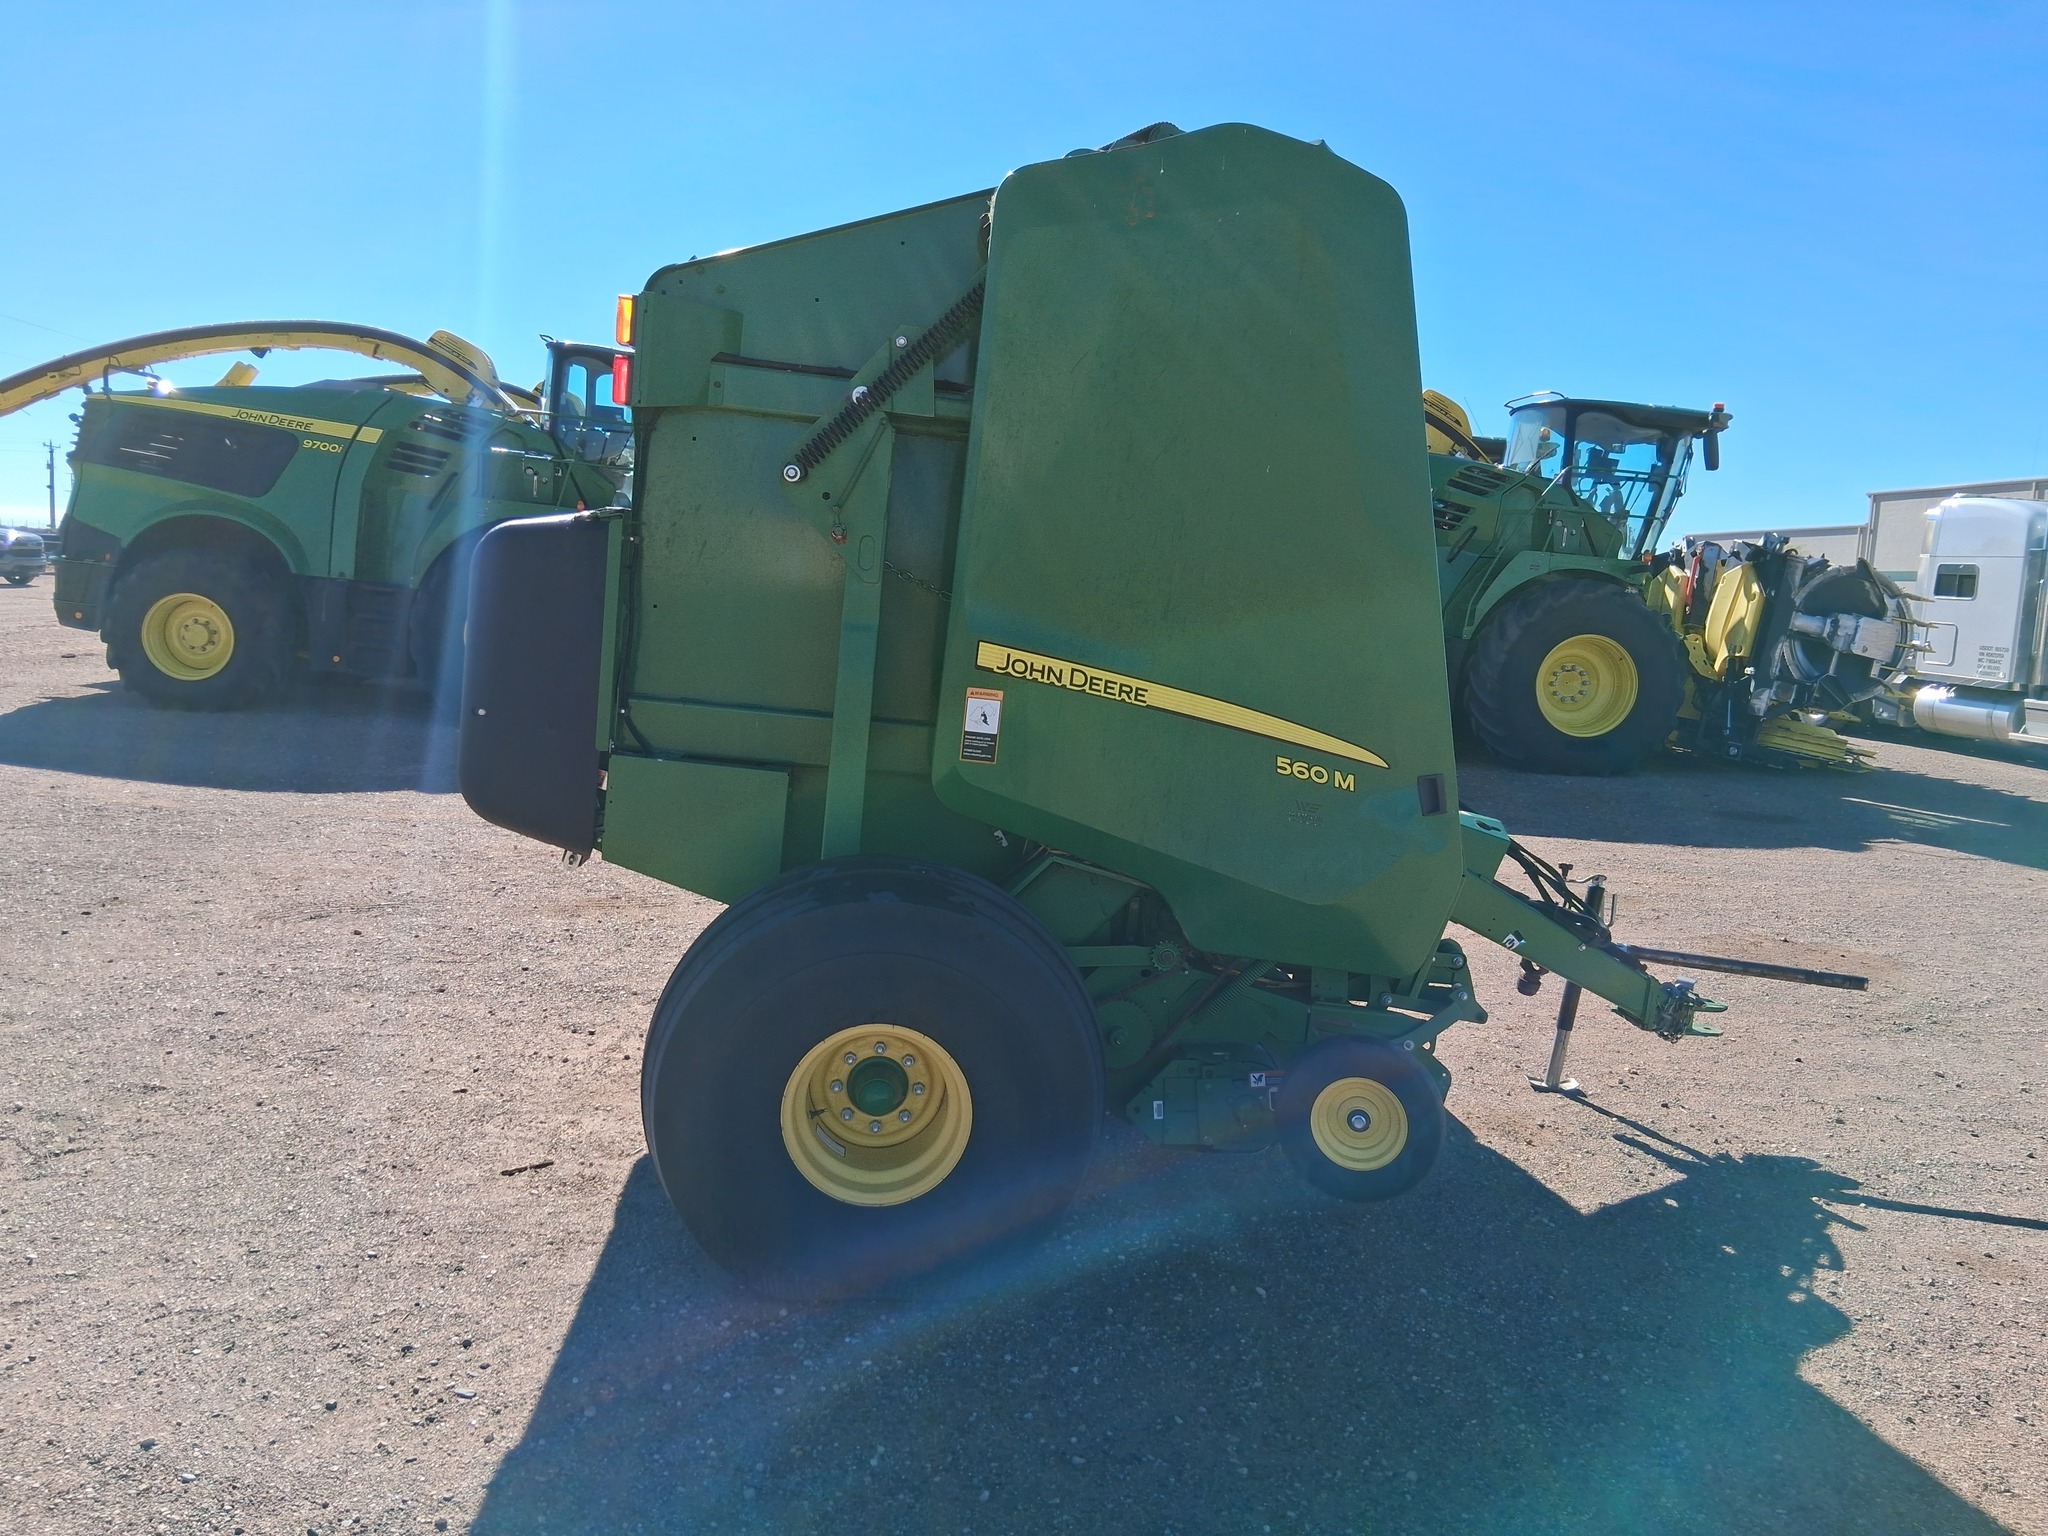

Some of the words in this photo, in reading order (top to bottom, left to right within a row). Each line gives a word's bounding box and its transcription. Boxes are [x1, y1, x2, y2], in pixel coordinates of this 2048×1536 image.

[231, 409, 267, 423] JOHN
[268, 414, 313, 431] DEERE
[302, 439, 344, 454] 9700i
[996, 652, 1063, 684] JOHN
[1069, 667, 1149, 704] DEERE
[974, 690, 999, 698] WARNING
[1276, 755, 1329, 784] 560
[1333, 769, 1355, 792] M
